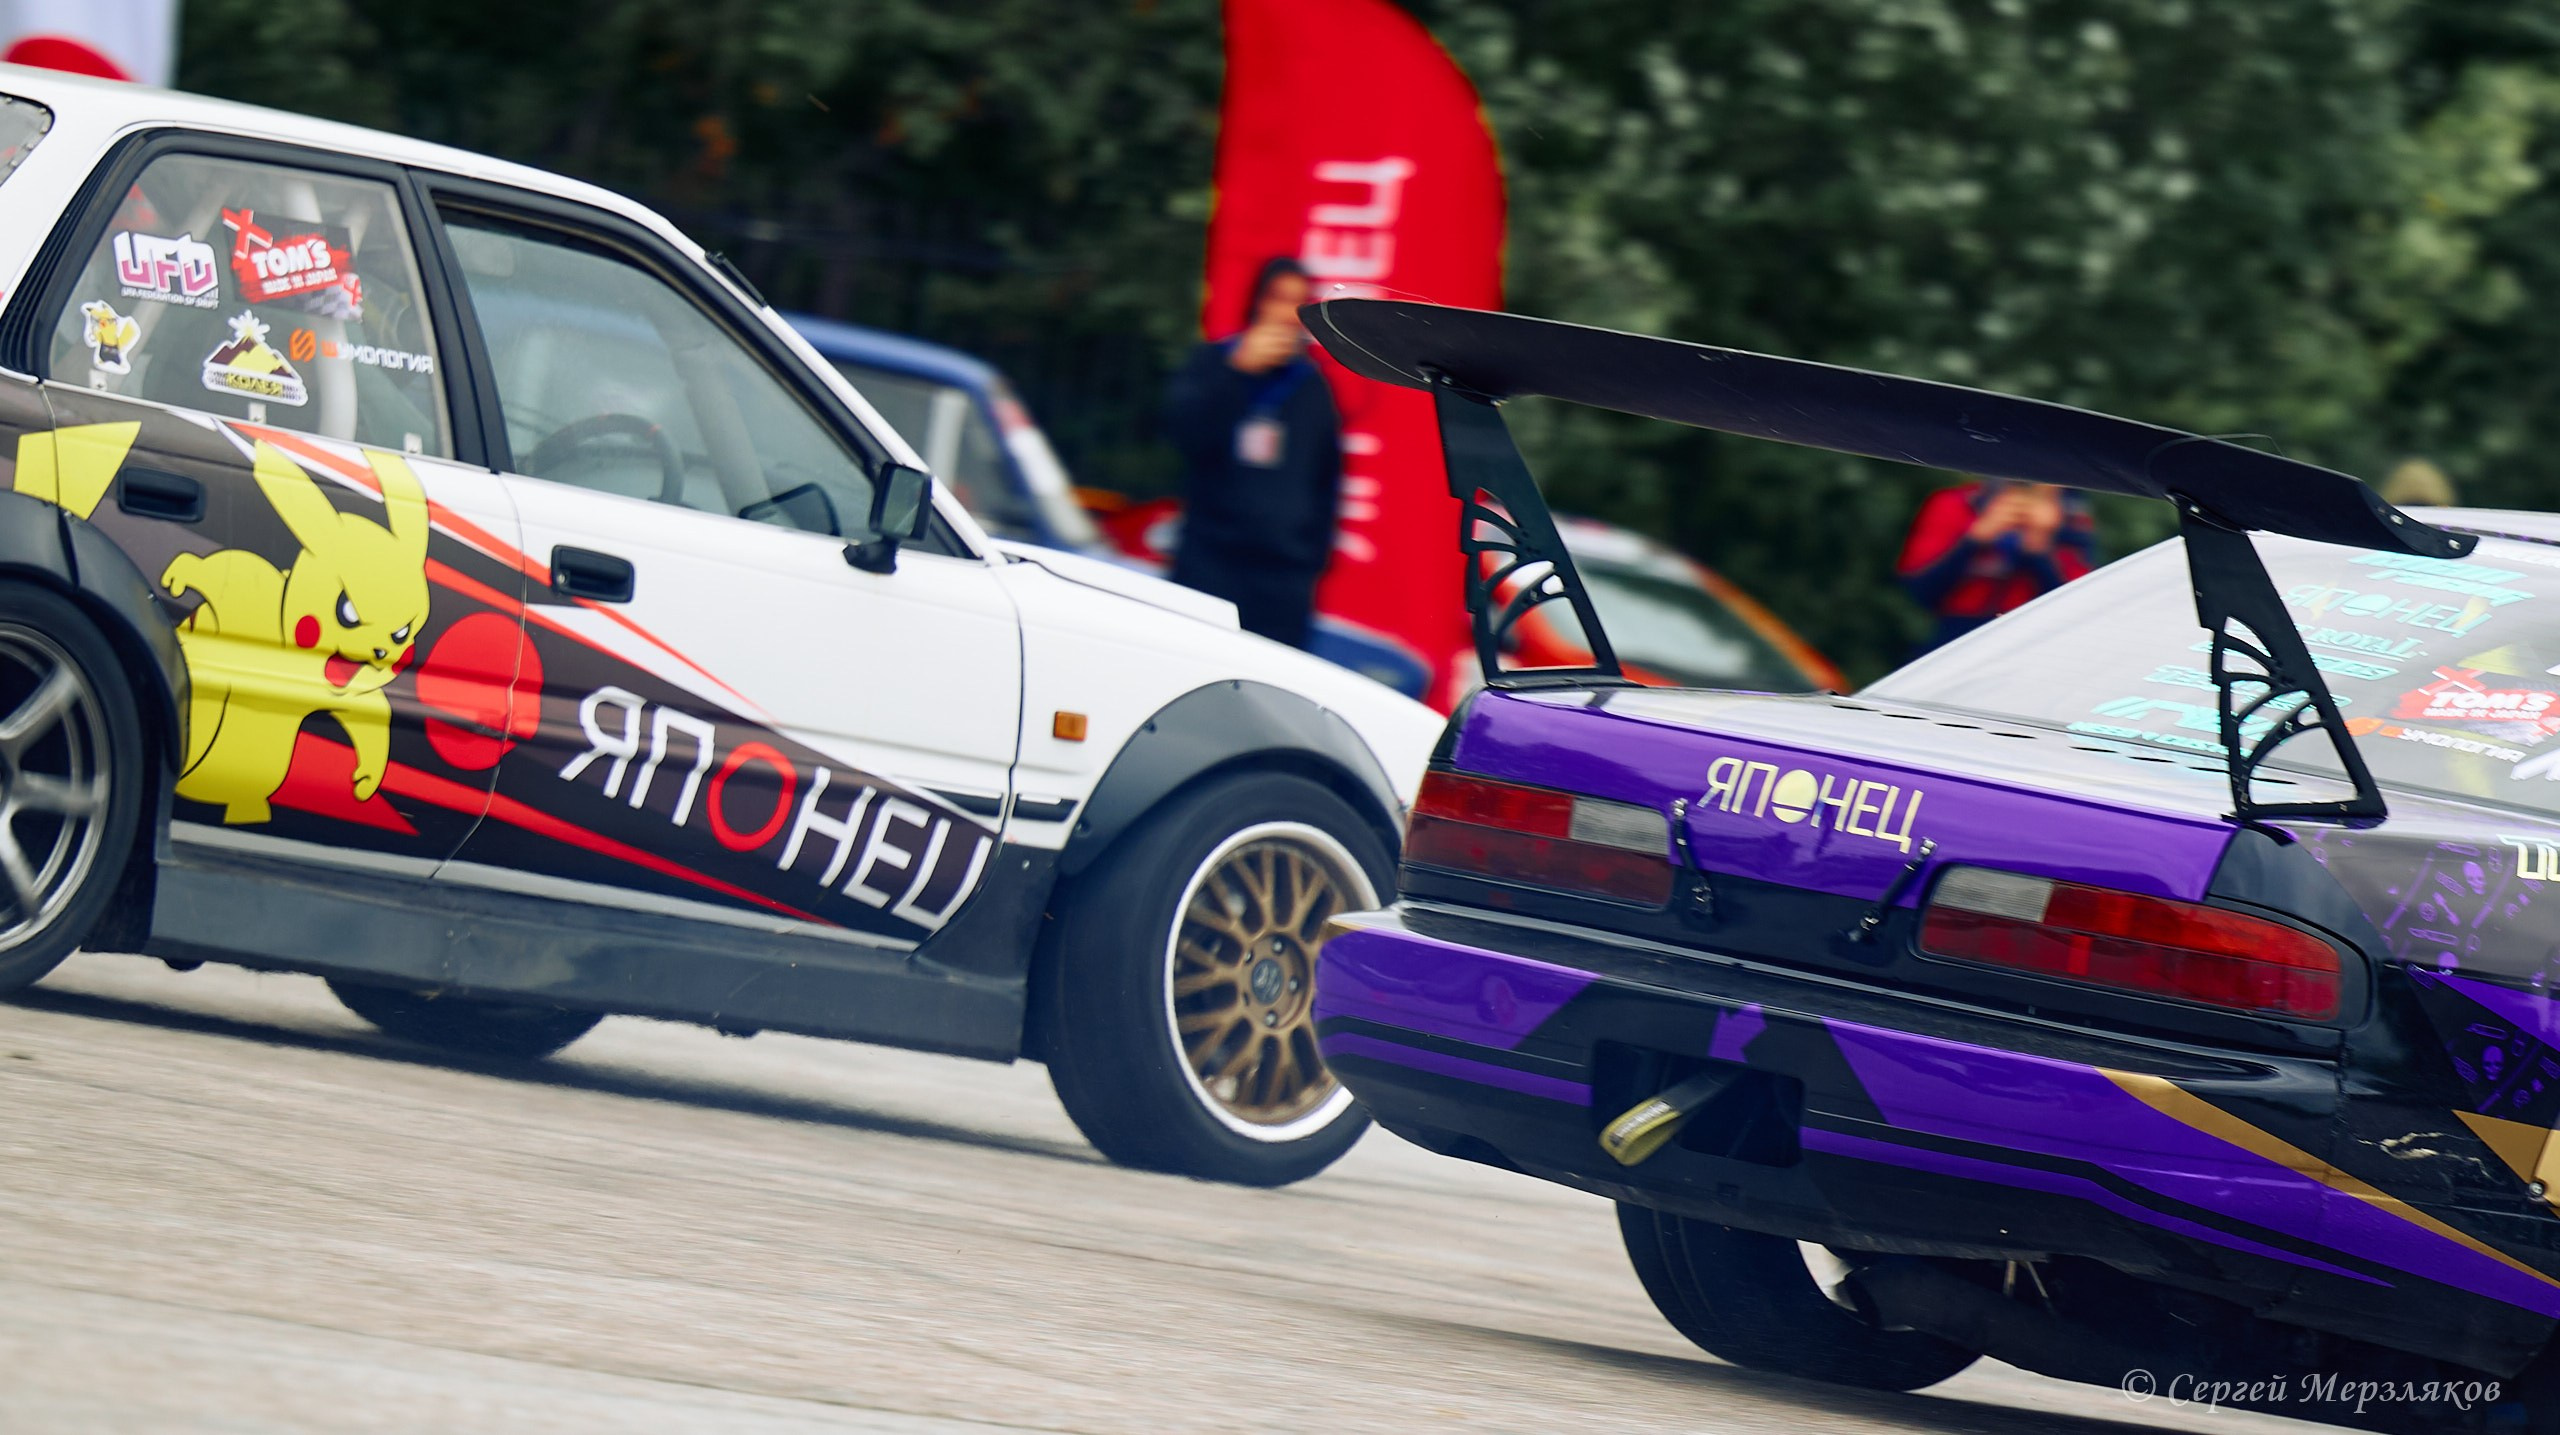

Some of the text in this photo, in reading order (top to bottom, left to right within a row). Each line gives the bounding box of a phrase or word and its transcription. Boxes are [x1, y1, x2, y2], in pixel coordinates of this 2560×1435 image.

[114, 231, 218, 297] UFD
[250, 239, 331, 279] TOM'S
[226, 373, 282, 396] КОЛЕЯ
[321, 340, 434, 375] ШУМОЛОГИЯ
[2284, 584, 2492, 638] ЯПОНЕЦ
[558, 686, 994, 932] ЯПОНЕЦ
[1697, 756, 1924, 854] ЯПОНЕЦ
